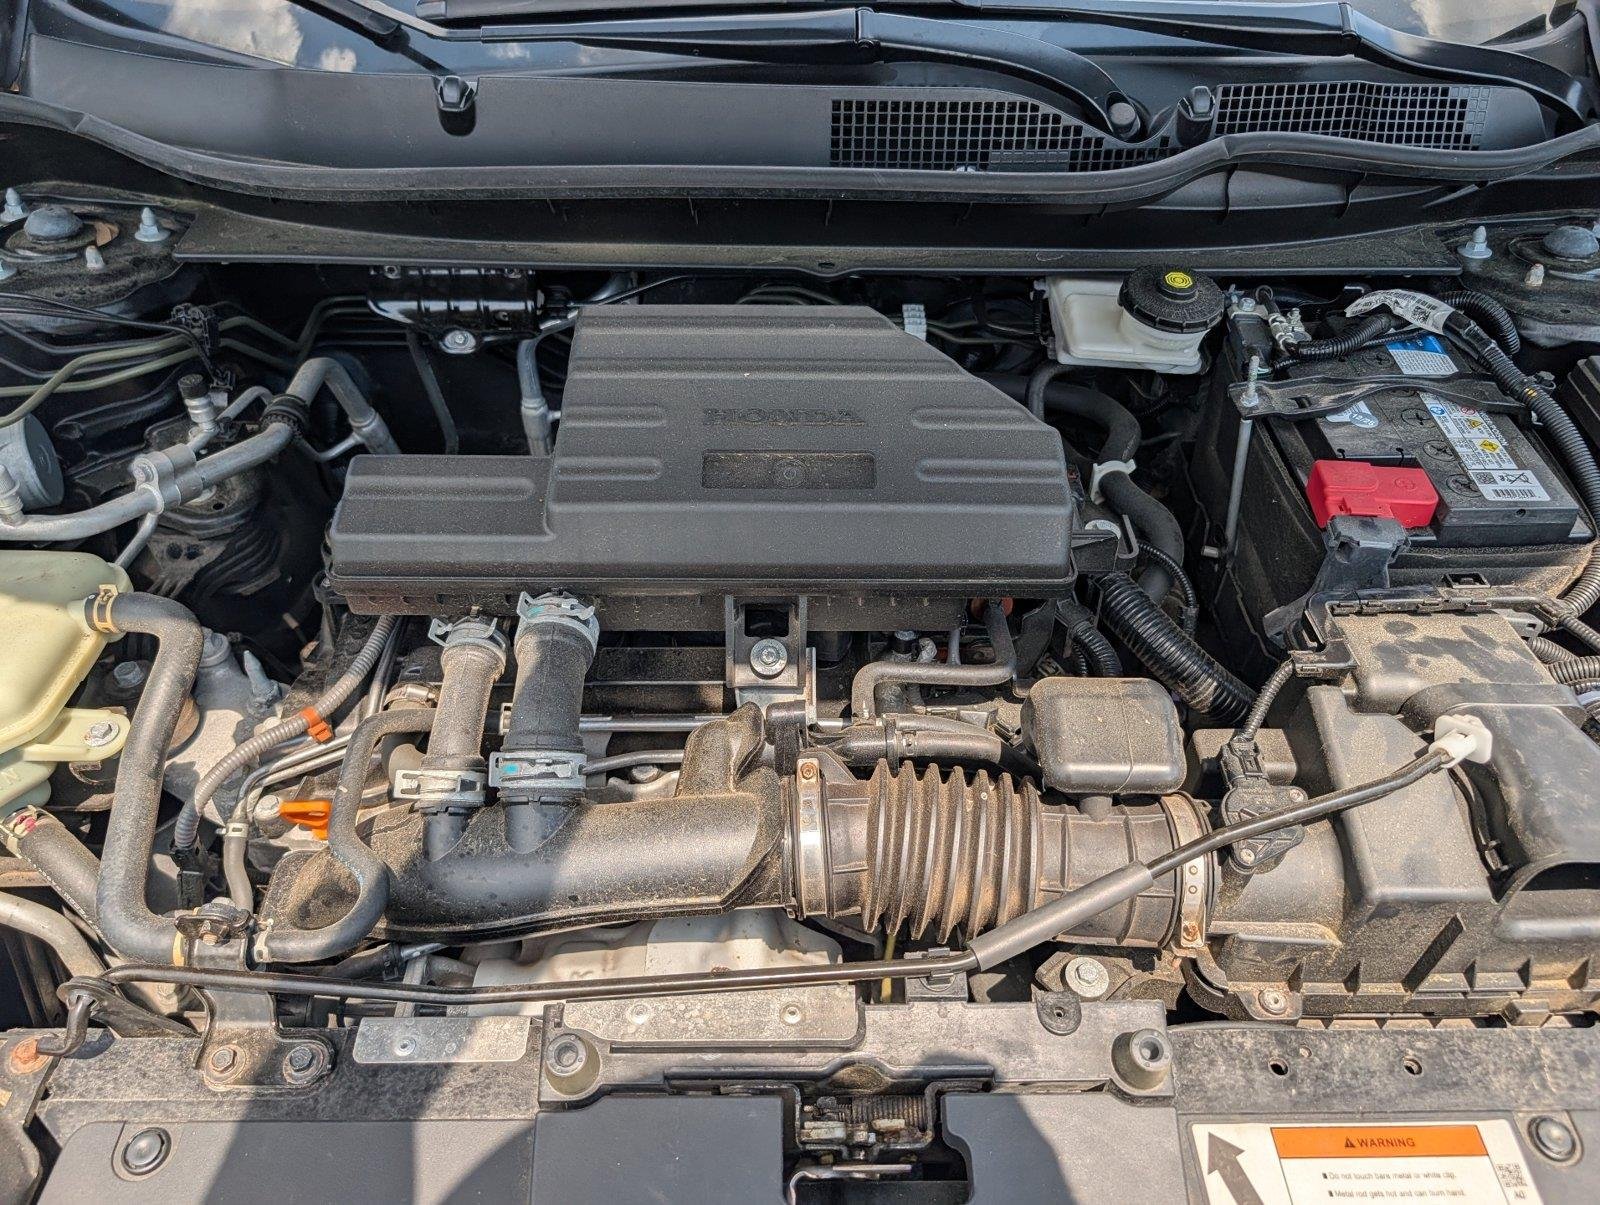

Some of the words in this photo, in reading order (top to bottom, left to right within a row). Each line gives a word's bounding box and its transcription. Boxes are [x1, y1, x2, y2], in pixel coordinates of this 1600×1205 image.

[704, 408, 866, 427] HONDA
[1357, 1137, 1416, 1148] WARNING
[1335, 1190, 1355, 1198] Metal
[1369, 1190, 1385, 1199] gets
